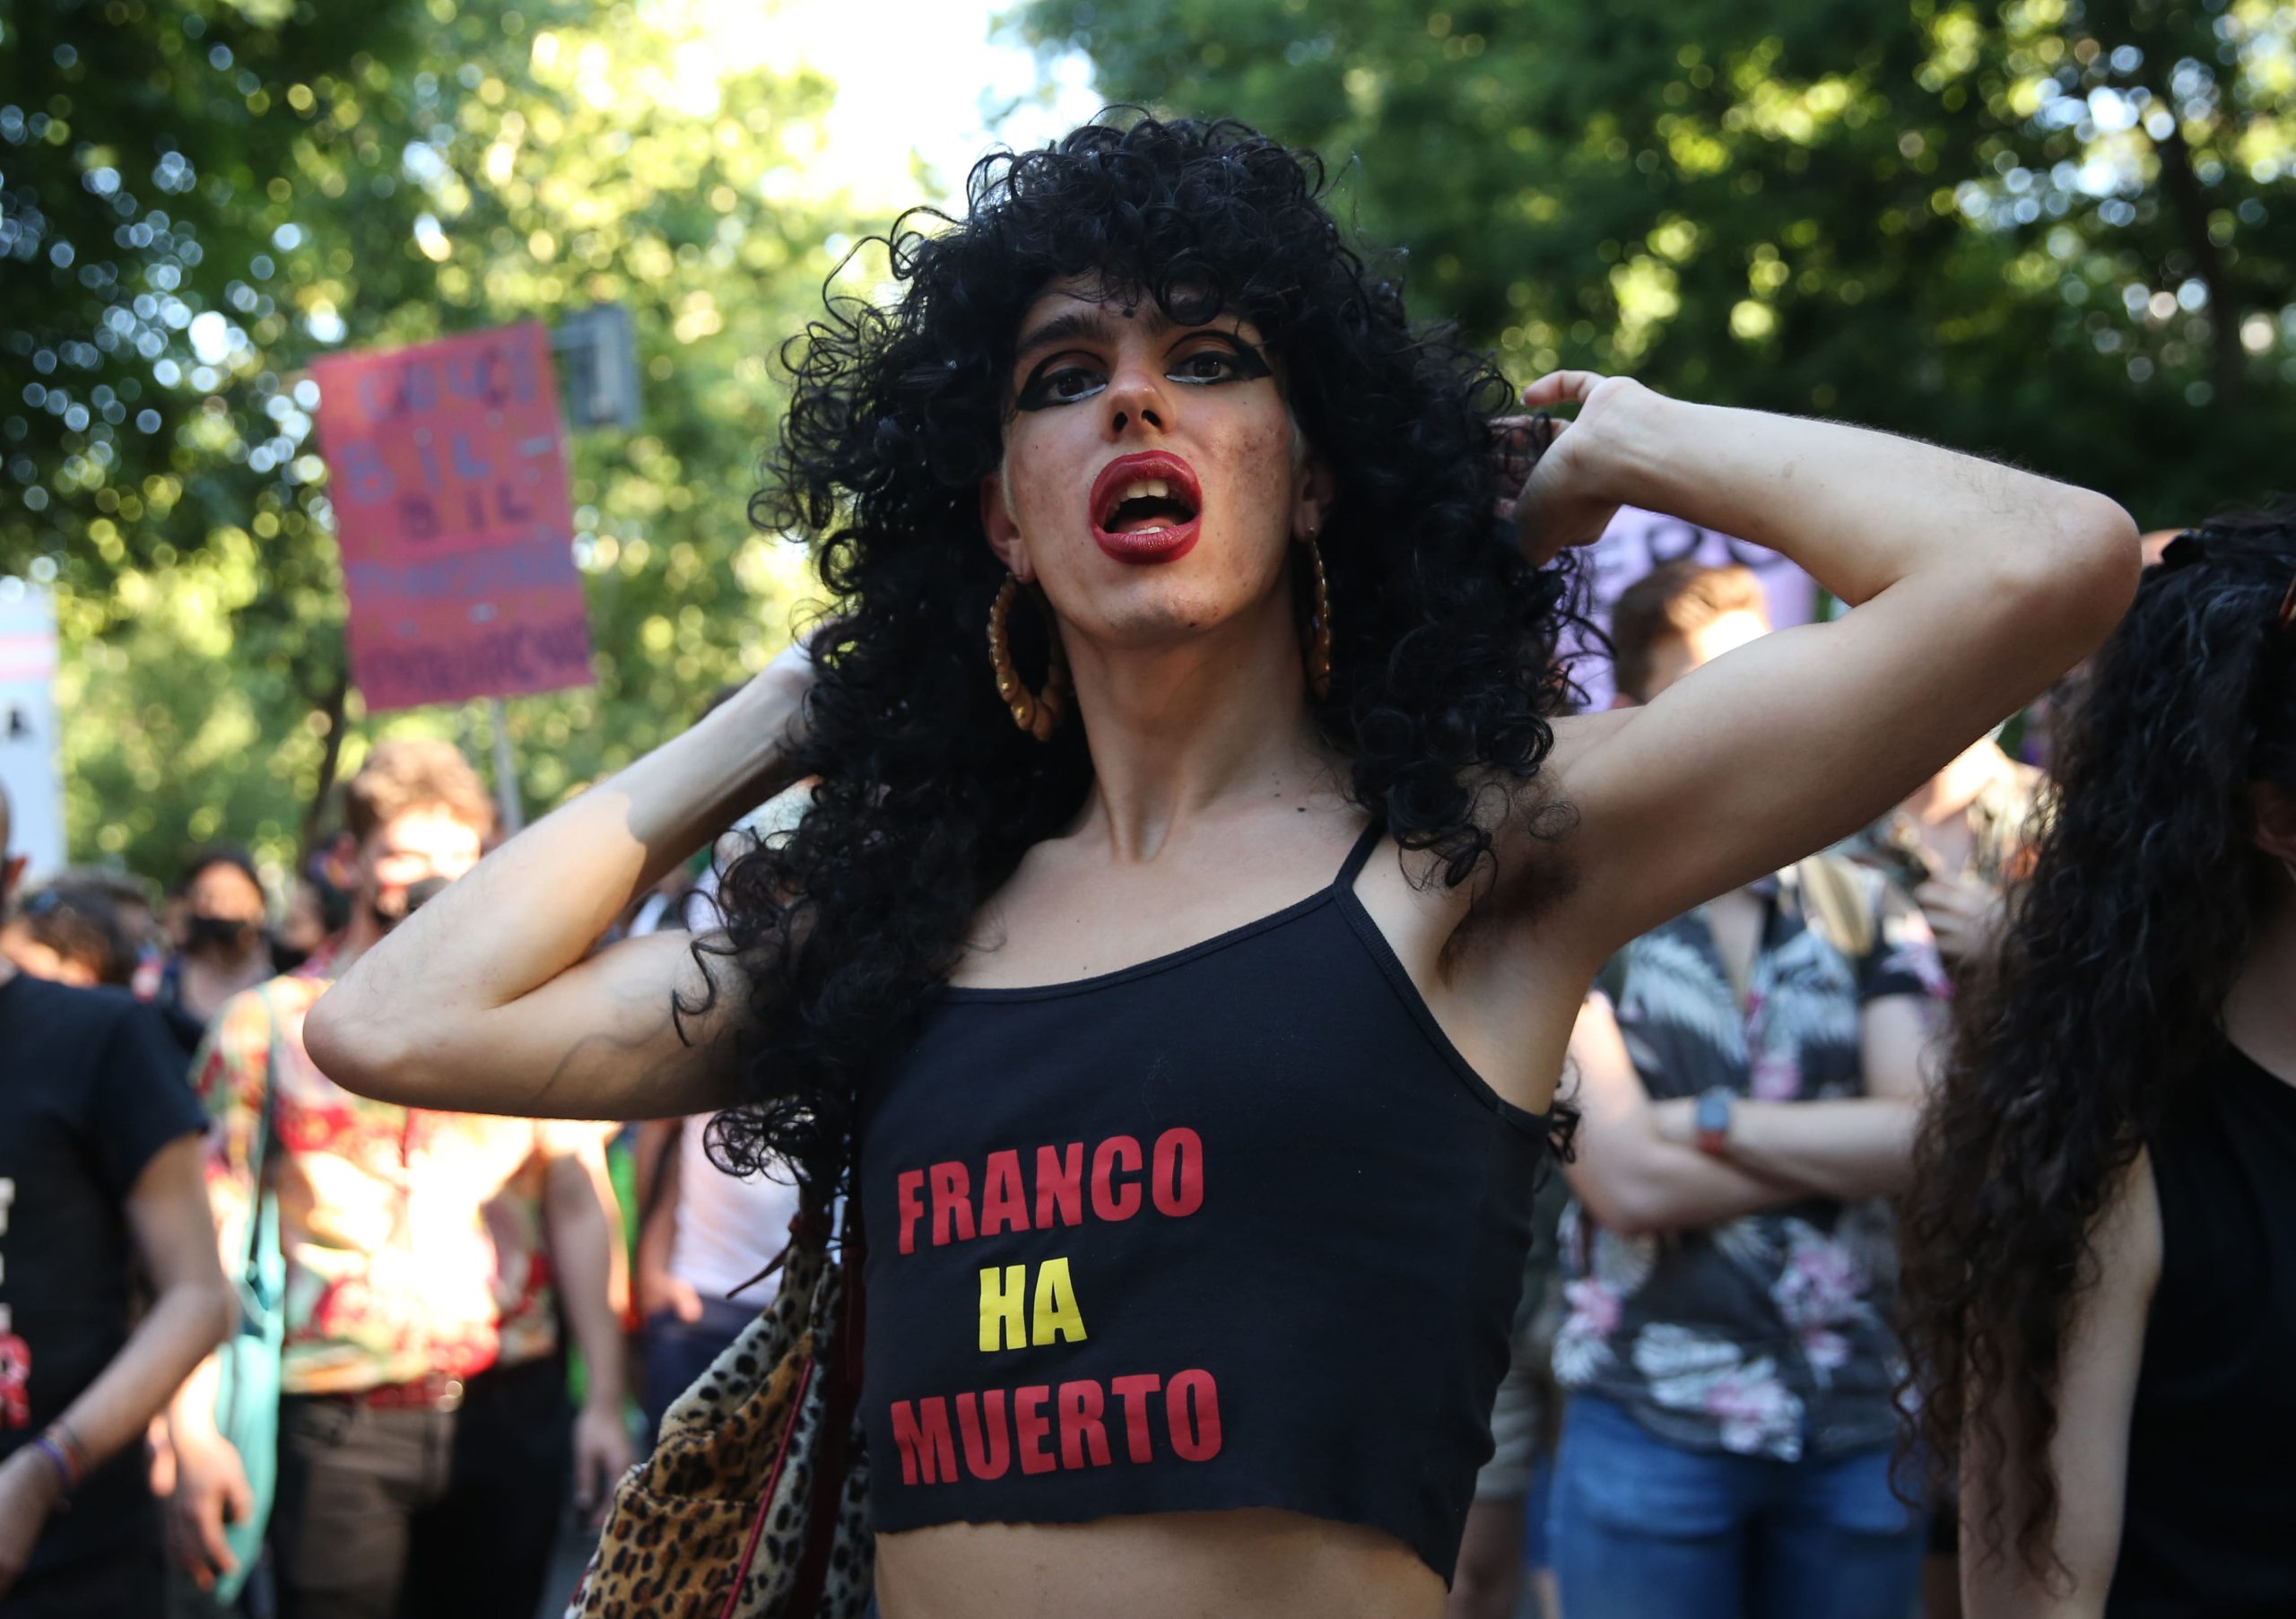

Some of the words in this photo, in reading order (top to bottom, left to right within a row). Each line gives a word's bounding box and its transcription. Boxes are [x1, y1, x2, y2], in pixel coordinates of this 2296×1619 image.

[898, 1127, 1205, 1255] FRANCO
[978, 1257, 1088, 1353] HA
[890, 1368, 1222, 1485] MUERTO
